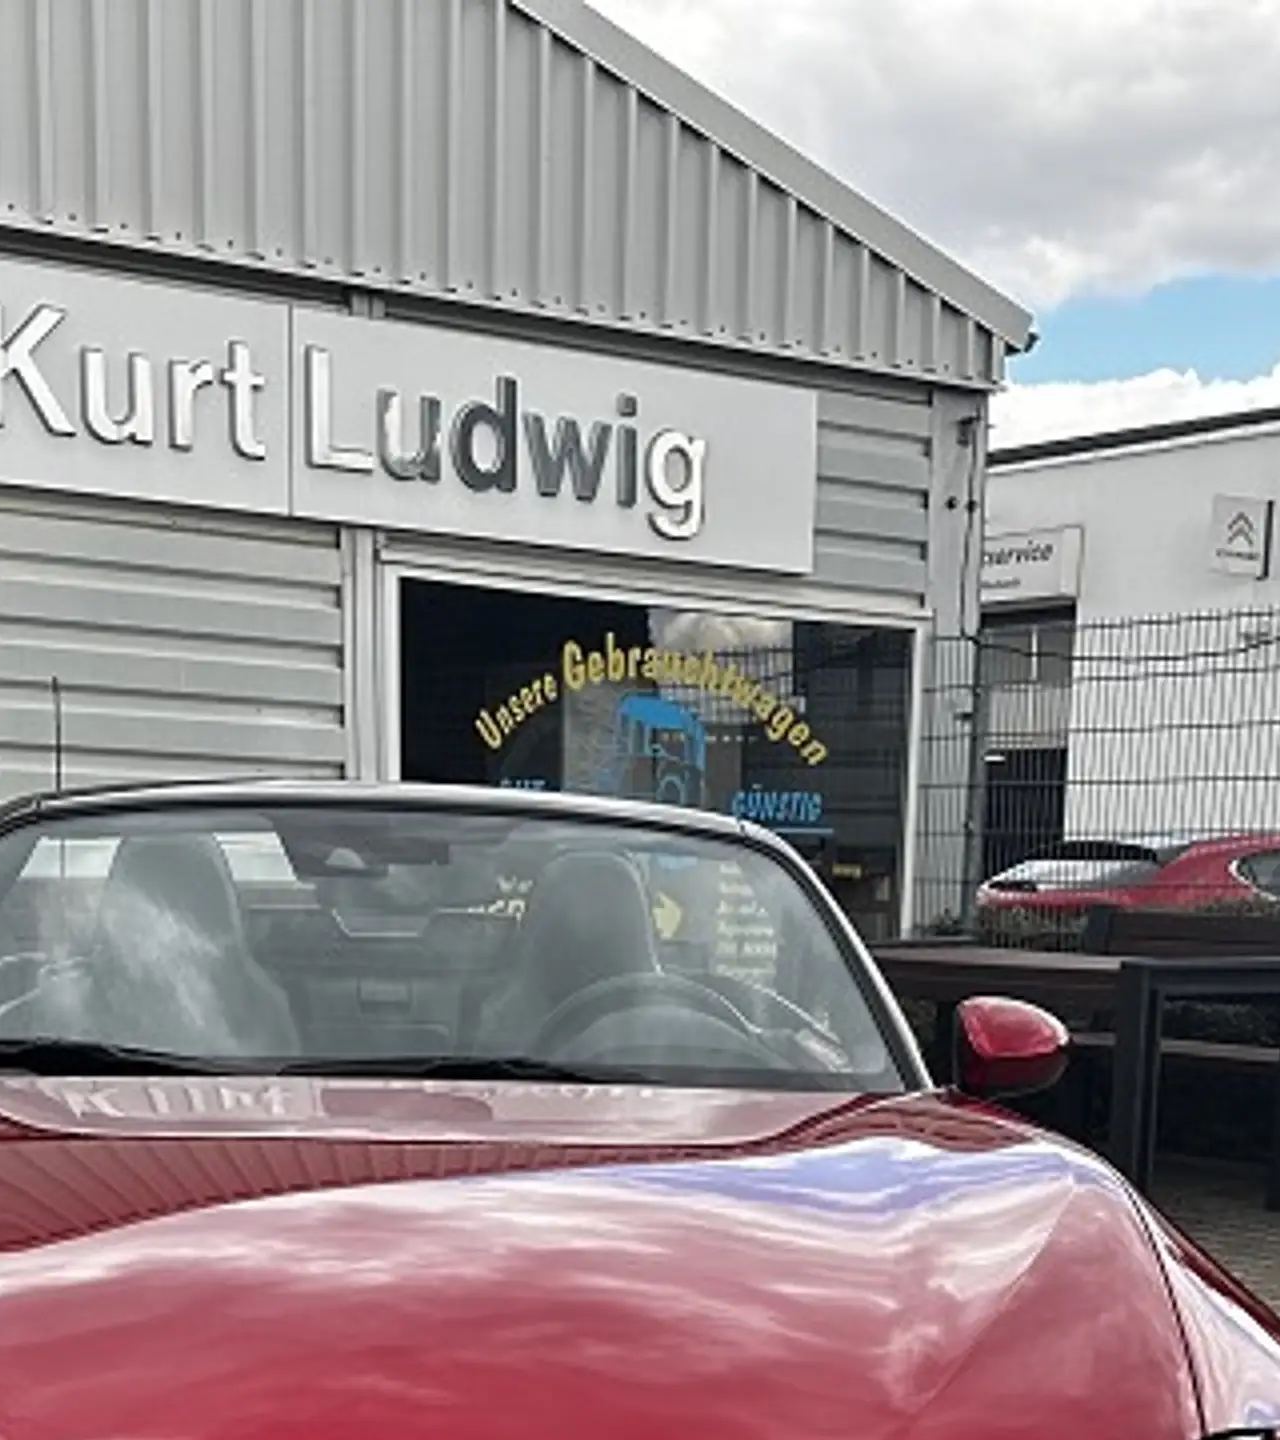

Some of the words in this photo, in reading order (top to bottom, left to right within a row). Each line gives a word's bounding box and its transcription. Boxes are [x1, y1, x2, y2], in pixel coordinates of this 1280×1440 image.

[304, 344, 707, 538] Ludwig
[475, 673, 558, 749] Unsere
[562, 632, 829, 766] Gebrauchtwagen
